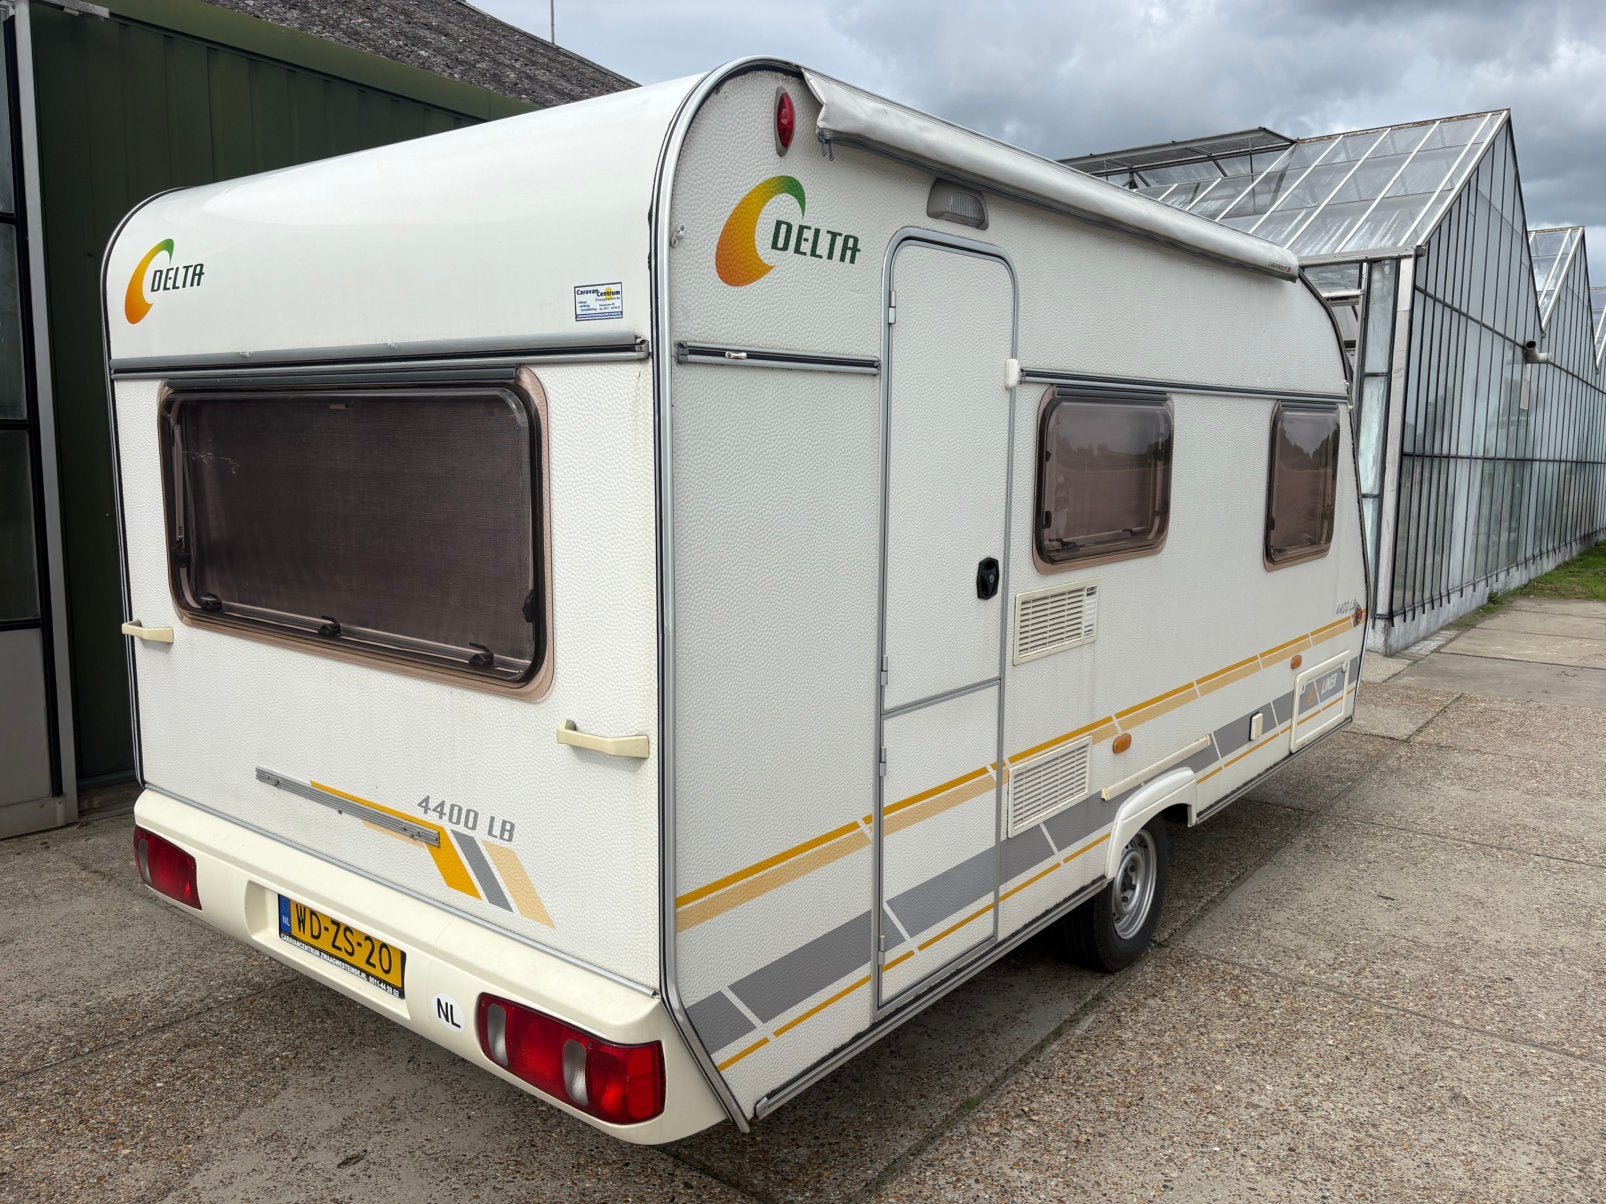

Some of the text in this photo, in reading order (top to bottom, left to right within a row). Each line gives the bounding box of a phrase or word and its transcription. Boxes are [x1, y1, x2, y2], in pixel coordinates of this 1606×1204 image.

[771, 219, 861, 265] DELTA
[150, 263, 205, 292] DELTA
[417, 795, 515, 843] 4400 LB
[282, 915, 291, 926] NL
[280, 933, 321, 957] CARAVANCENTRUM
[295, 903, 392, 975] WD-ZS-20
[436, 998, 461, 1029] NL
